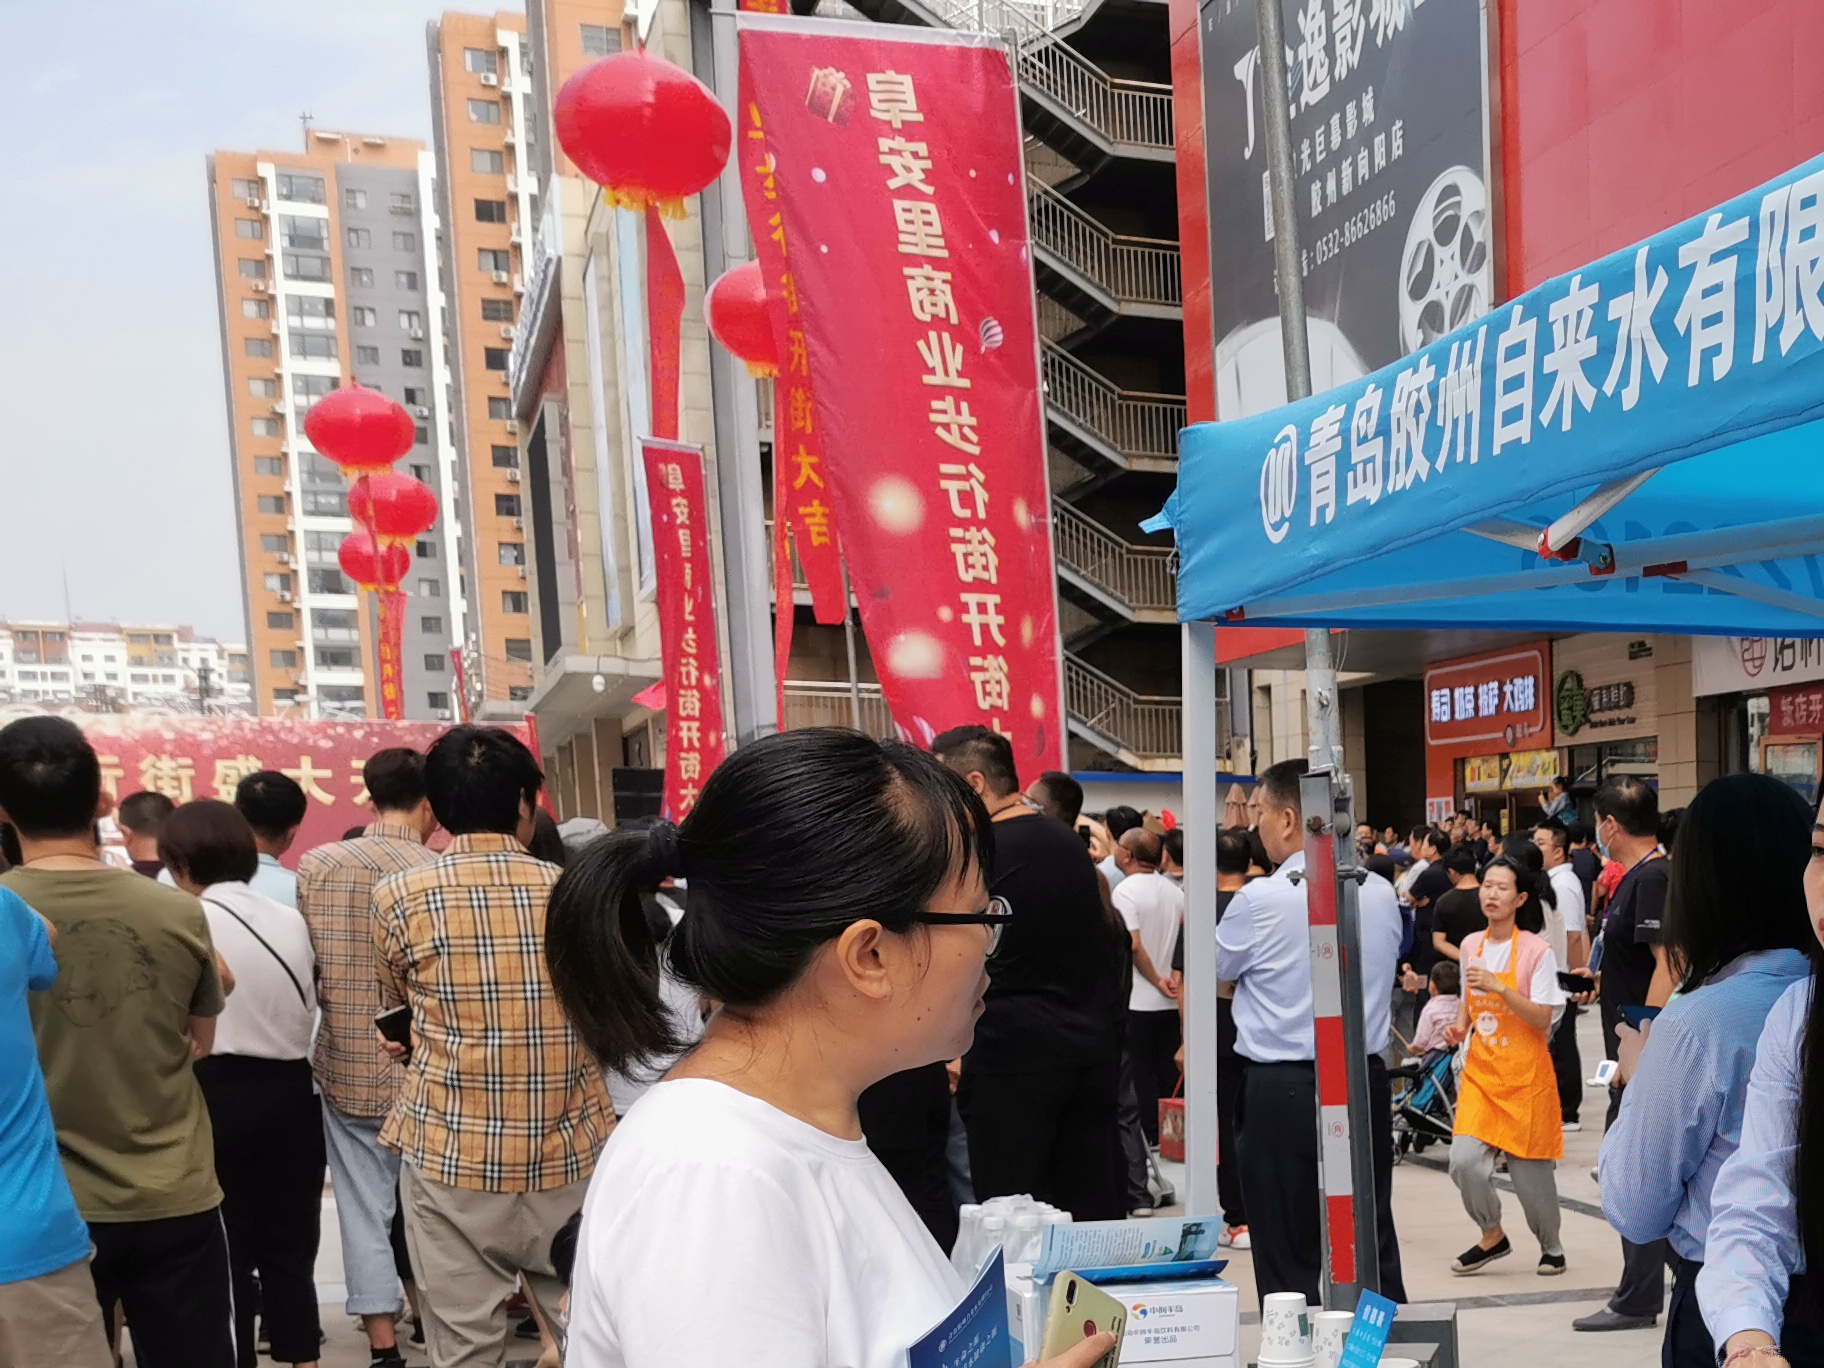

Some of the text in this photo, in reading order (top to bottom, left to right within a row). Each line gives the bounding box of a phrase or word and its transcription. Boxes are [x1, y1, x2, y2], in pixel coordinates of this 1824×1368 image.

[1293, 85, 1375, 180] 光巨幕影城
[1310, 119, 1404, 218] 胶州新向阳店
